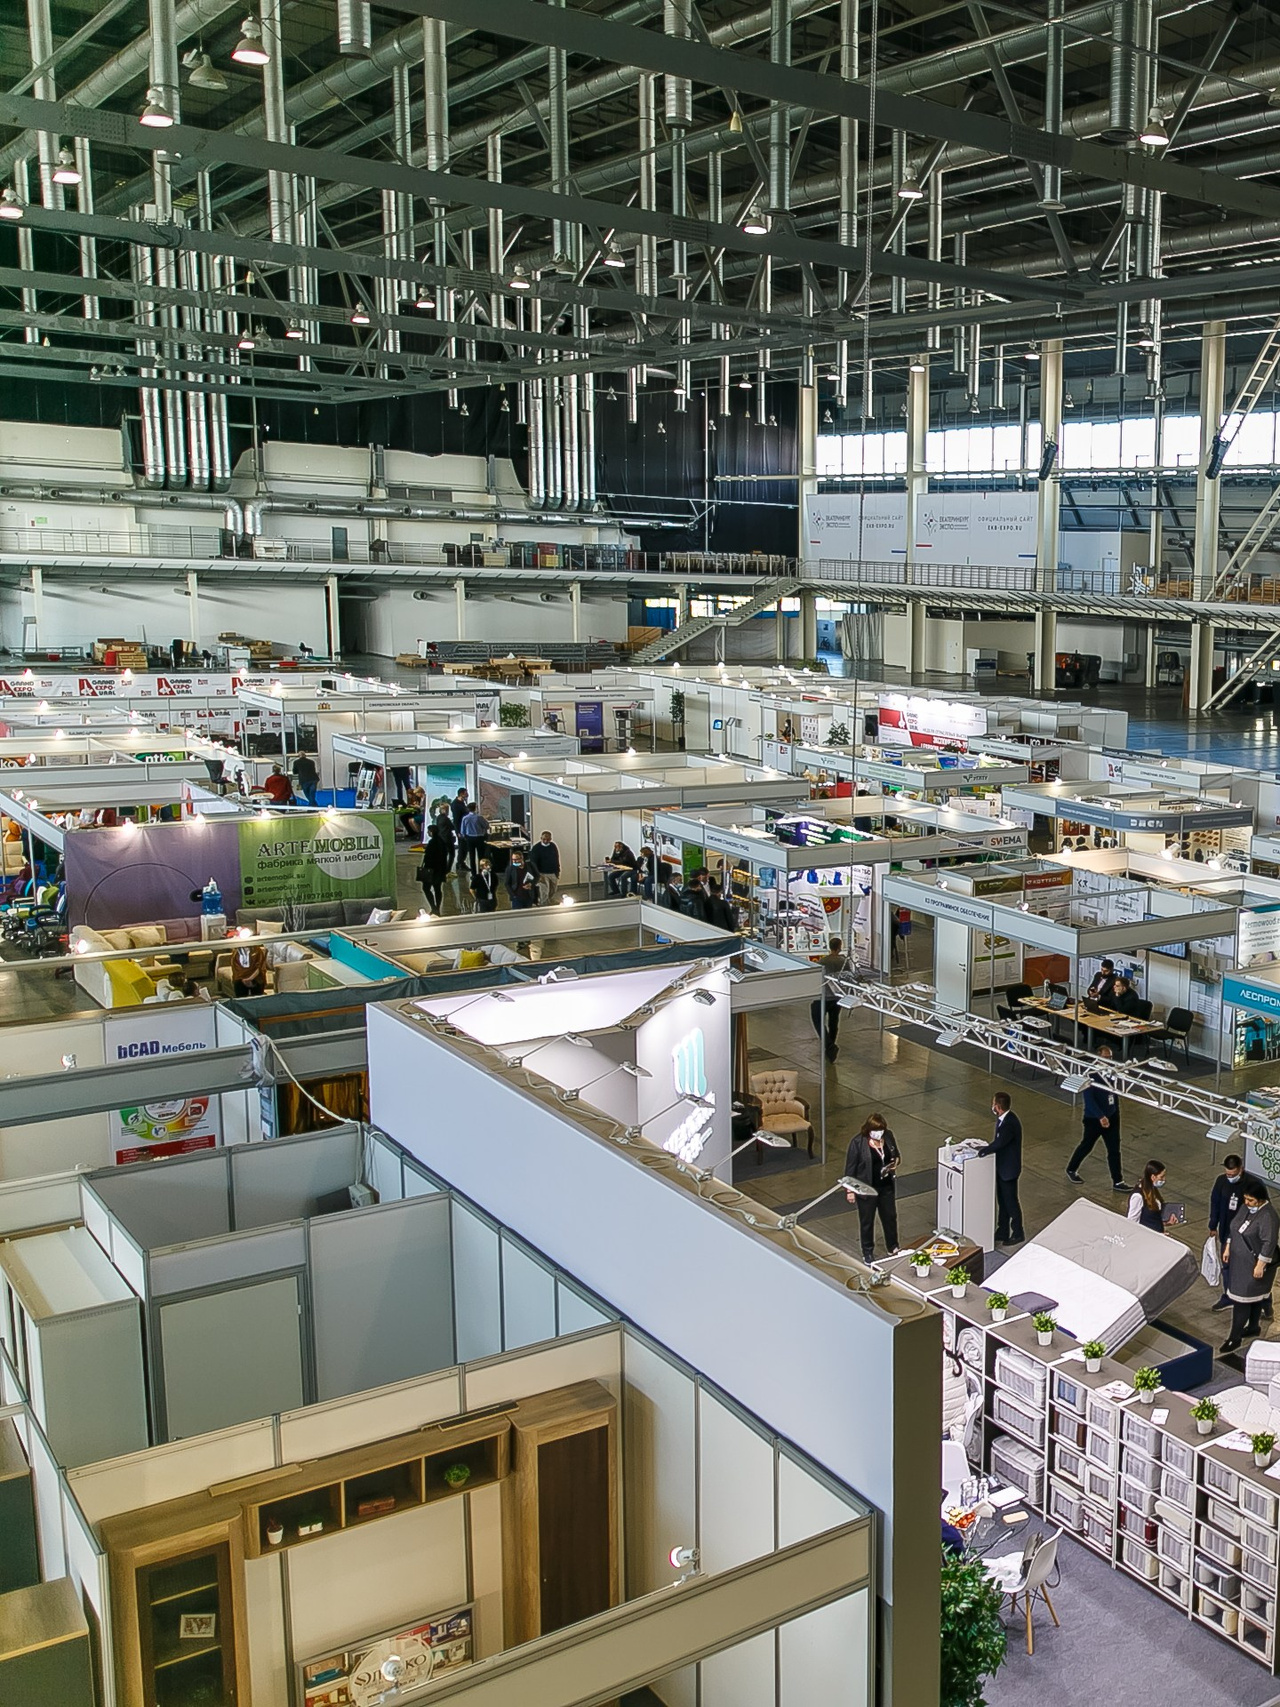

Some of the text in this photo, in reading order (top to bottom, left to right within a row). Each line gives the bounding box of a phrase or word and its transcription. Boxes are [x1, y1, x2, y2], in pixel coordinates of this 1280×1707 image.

[990, 835, 1022, 846] SWEMA
[257, 852, 381, 870] фабрика мягкой мебели
[930, 898, 959, 913] ПРОГРАММНОЕ
[959, 907, 990, 921] ОБЕСПЕЧЕНИЕ
[117, 1040, 207, 1059] bCAD Мебель
[354, 1654, 427, 1687] ОЛКО
